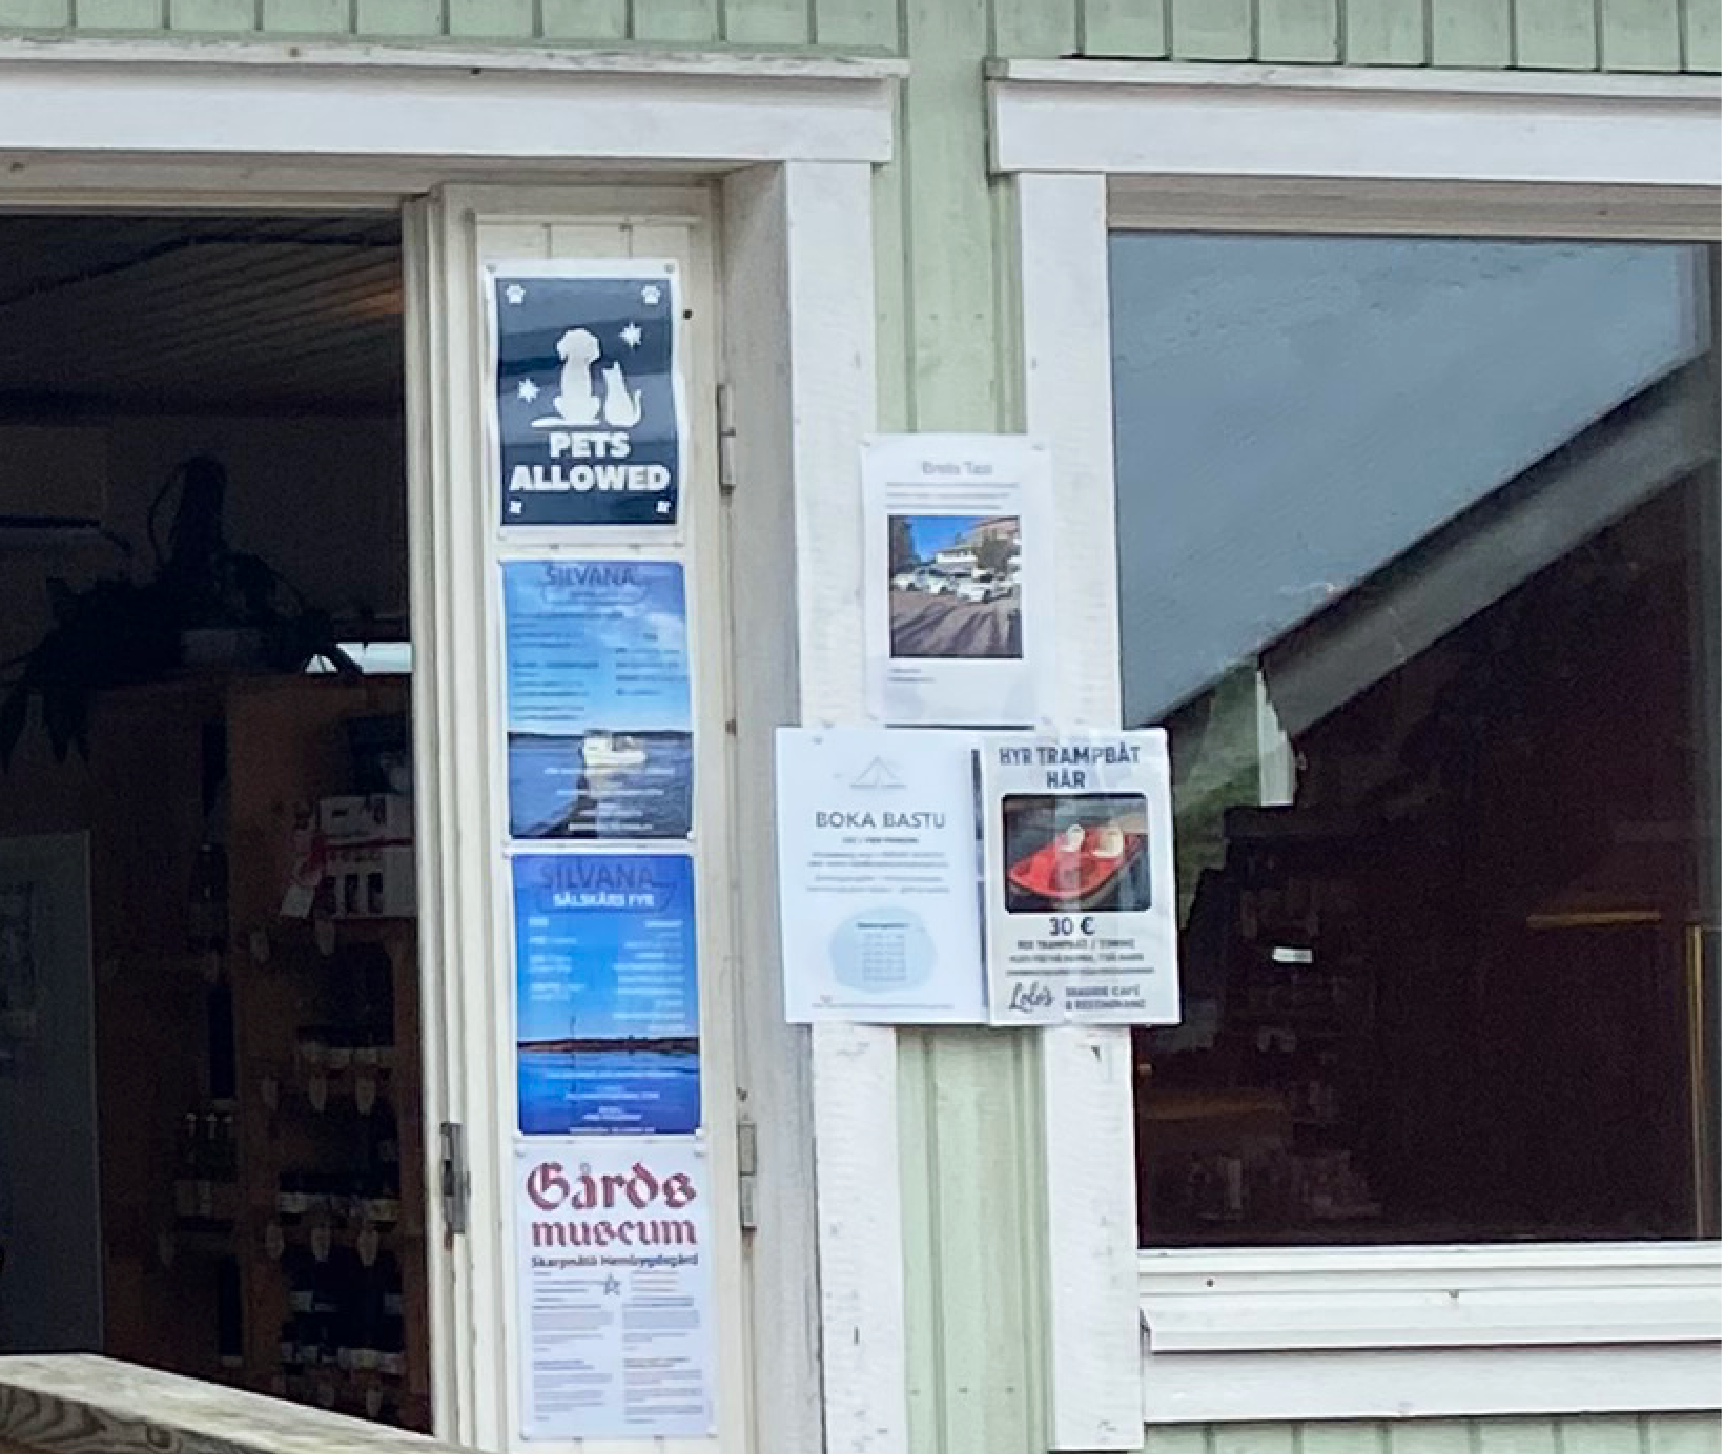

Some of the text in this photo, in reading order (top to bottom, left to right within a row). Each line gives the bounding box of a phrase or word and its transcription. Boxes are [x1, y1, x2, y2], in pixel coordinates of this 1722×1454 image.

[548, 431, 632, 459] PETS
[509, 464, 672, 491] ALLOWED
[999, 742, 1141, 766] HYR TRAMPBÅT
[816, 811, 945, 829] BOKA BASTU
[1049, 917, 1095, 936] 30 €
[527, 1162, 697, 1211] Gårds
[531, 1220, 698, 1247] museum
